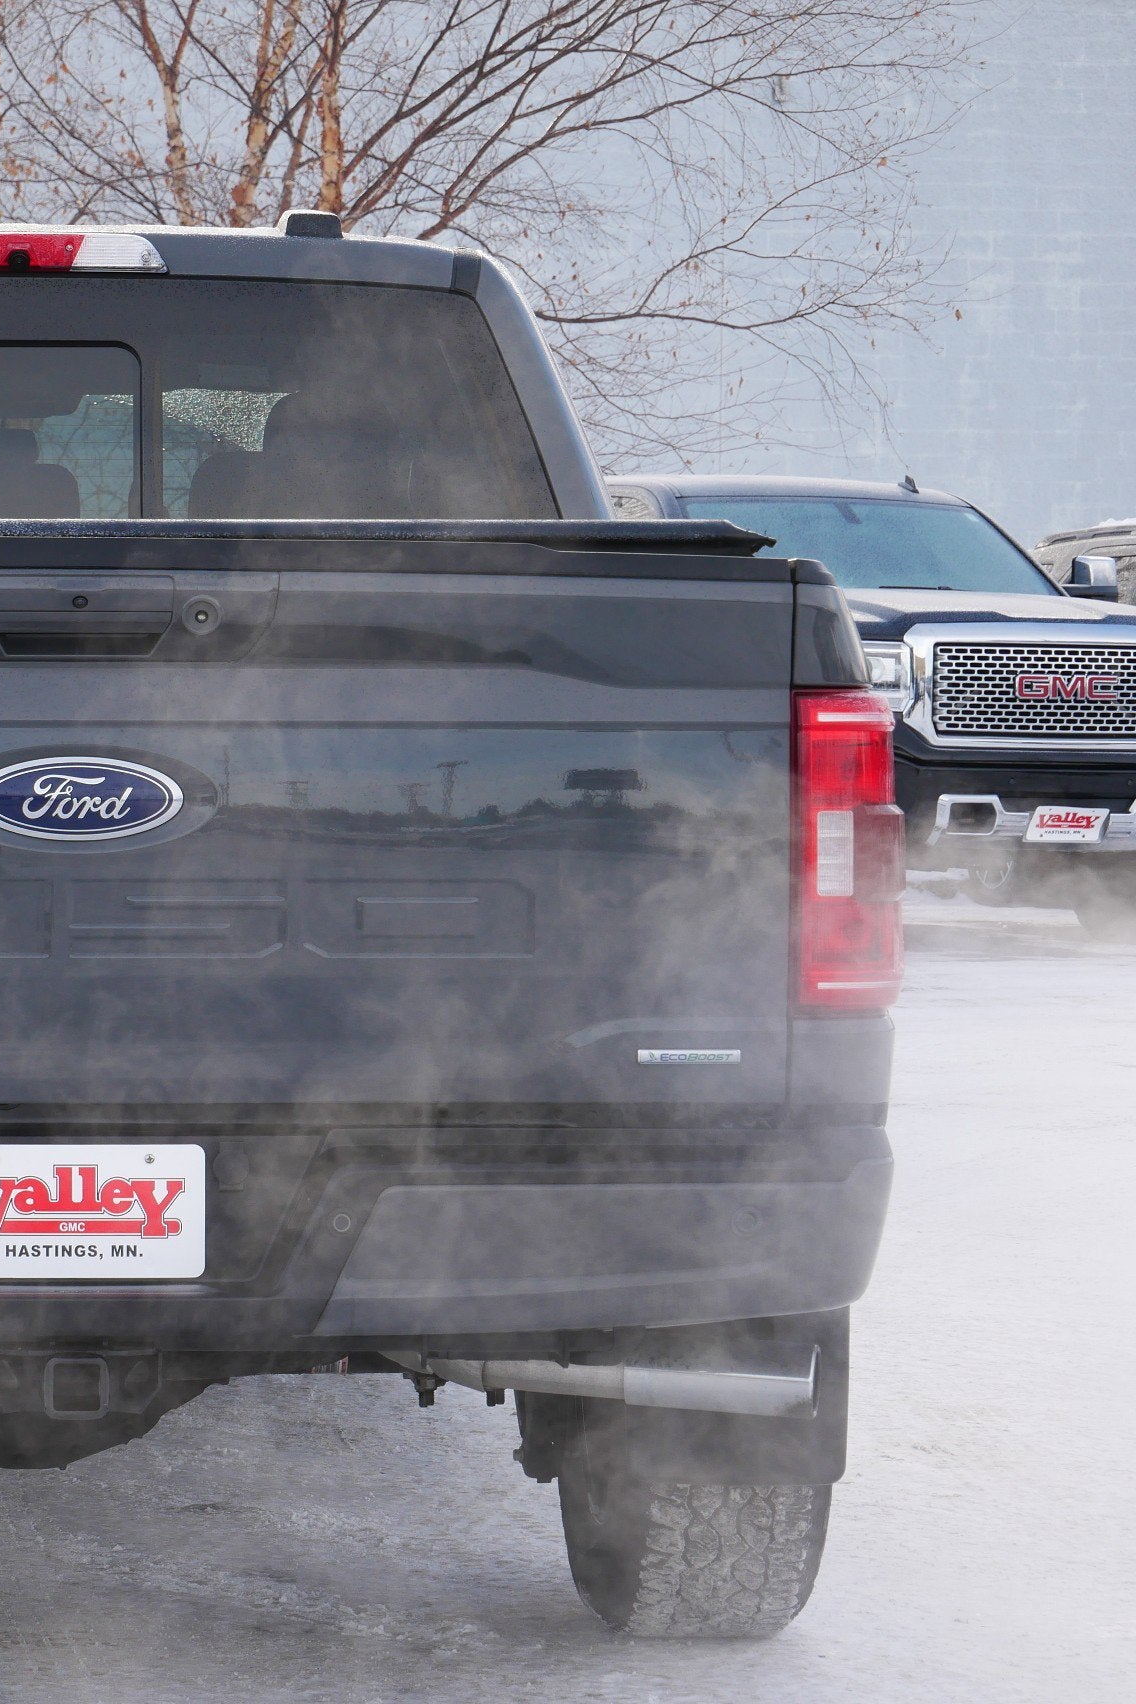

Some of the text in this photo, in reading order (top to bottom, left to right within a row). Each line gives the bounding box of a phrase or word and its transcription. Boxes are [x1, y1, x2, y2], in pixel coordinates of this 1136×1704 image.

[1015, 674, 1118, 700] GMC
[22, 774, 133, 819] Ford
[59, 1221, 86, 1232] GMC
[5, 1244, 143, 1259] HASTINGS, MN.
